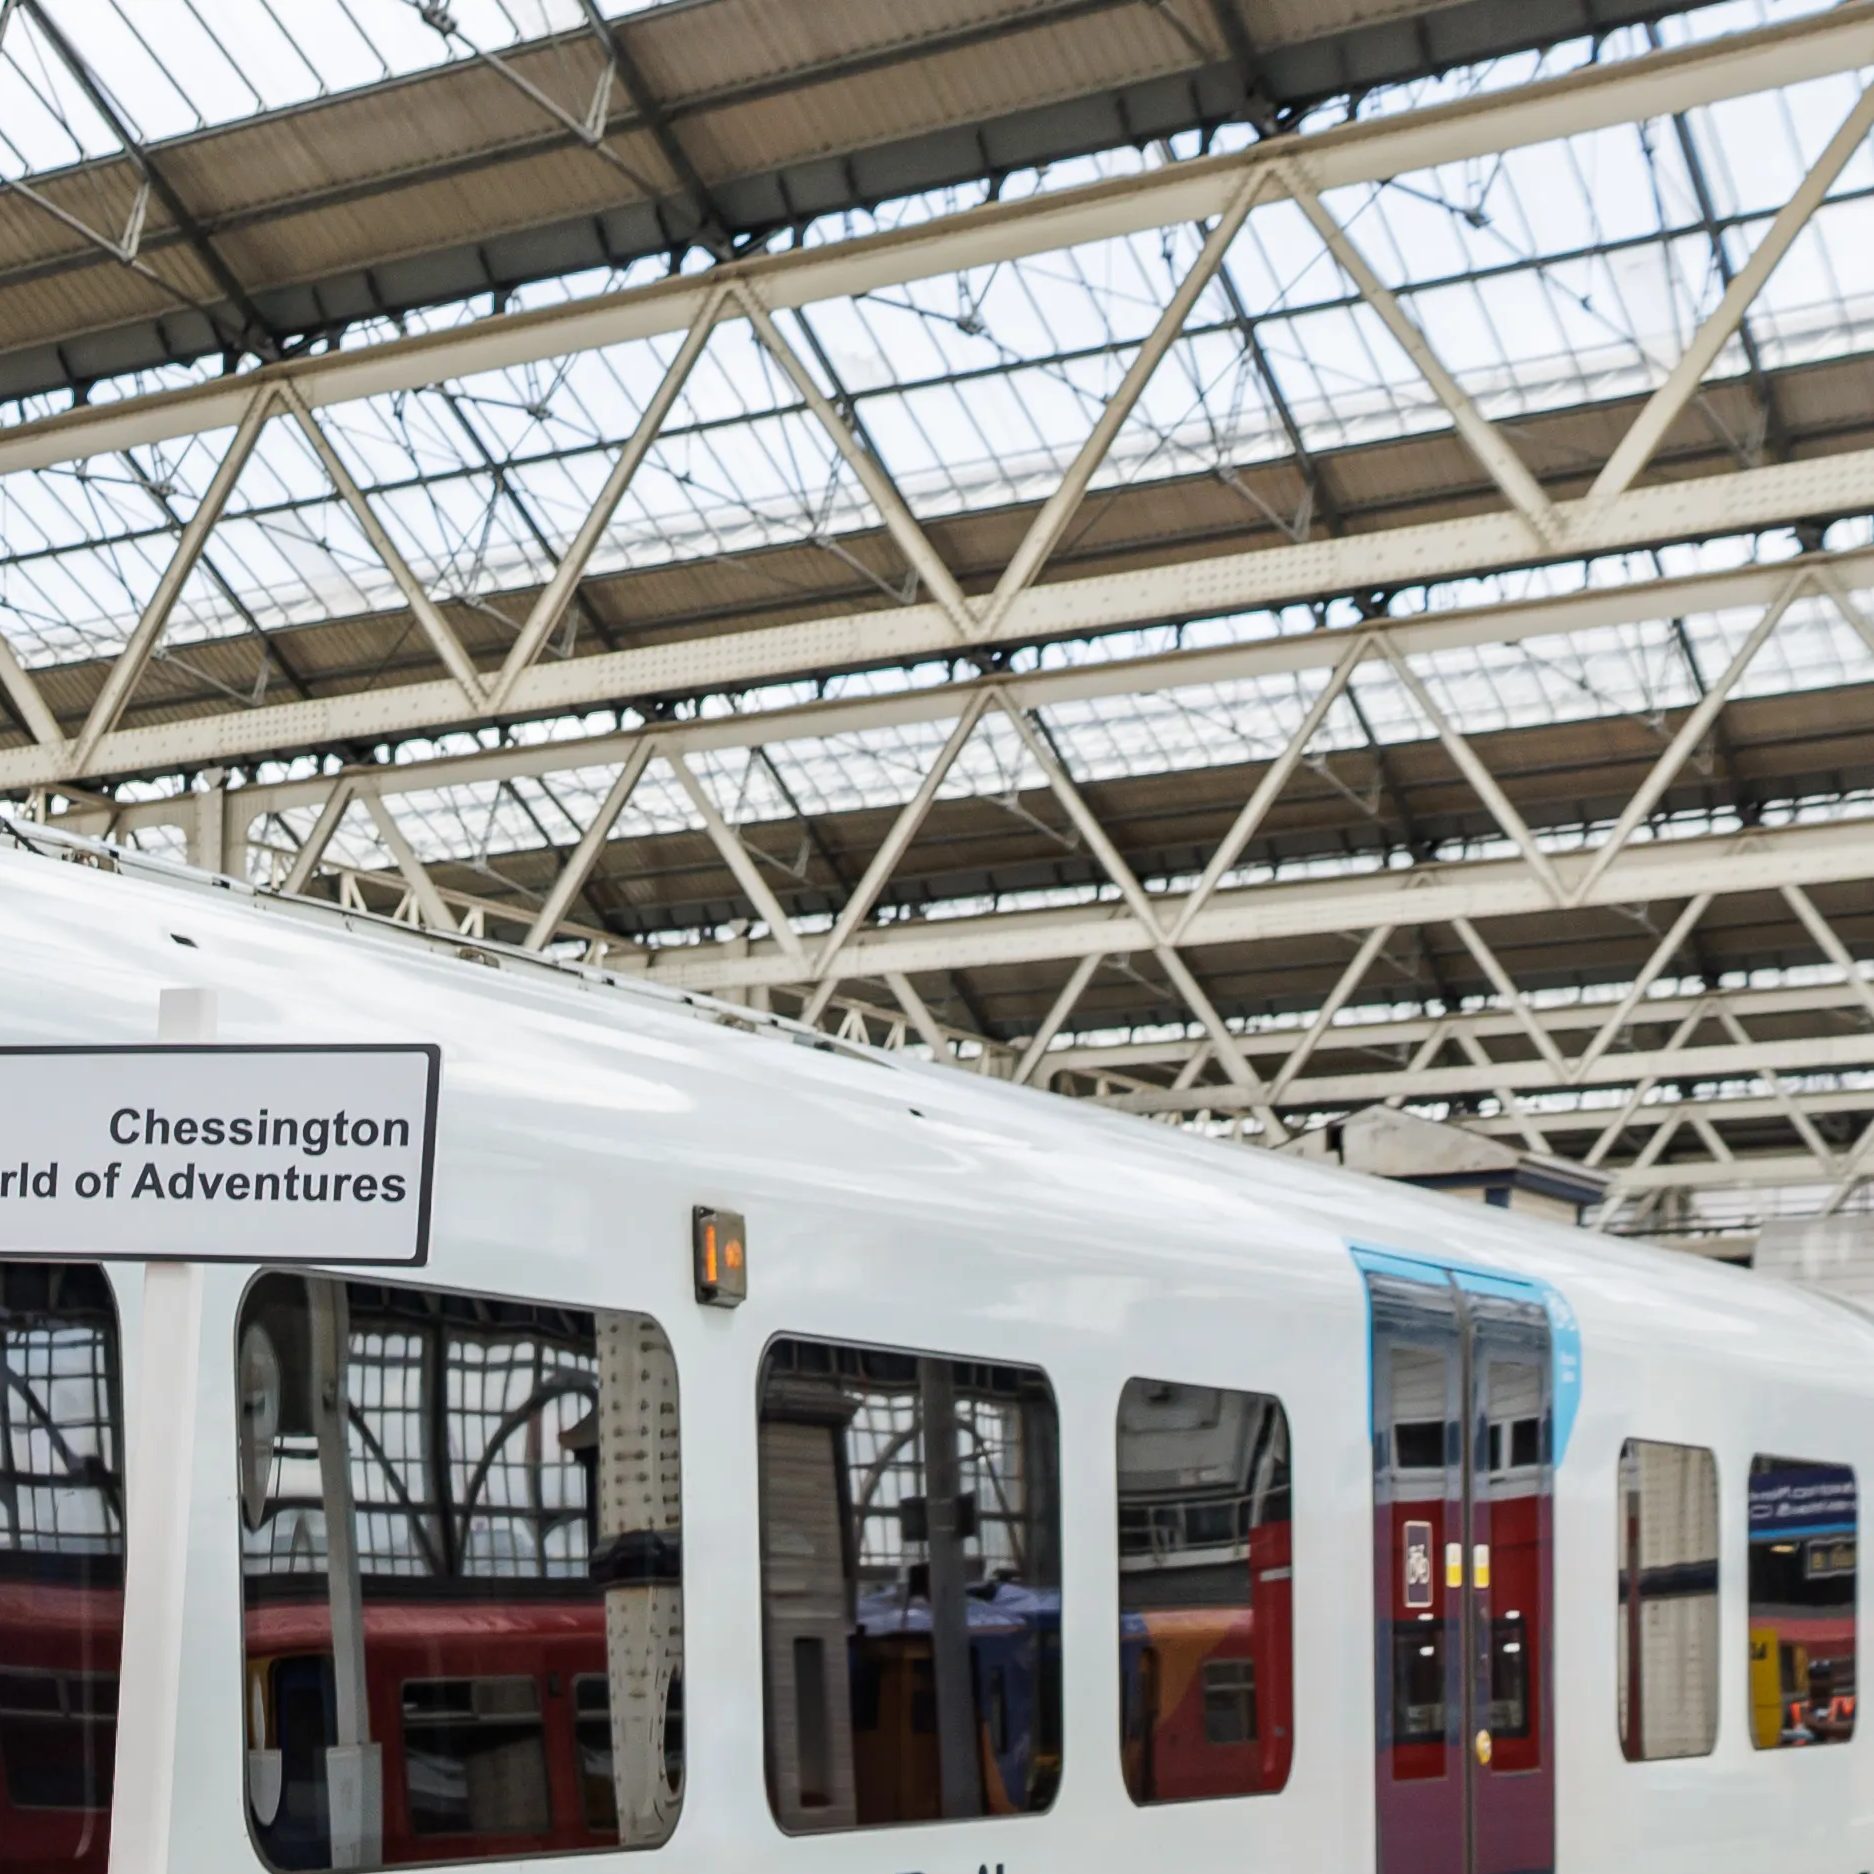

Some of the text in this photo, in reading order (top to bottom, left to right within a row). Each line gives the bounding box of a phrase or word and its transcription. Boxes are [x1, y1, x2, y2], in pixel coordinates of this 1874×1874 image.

[109, 1108, 409, 1156] Chessington
[75, 1162, 122, 1199] of
[131, 1162, 406, 1203] Adventures
